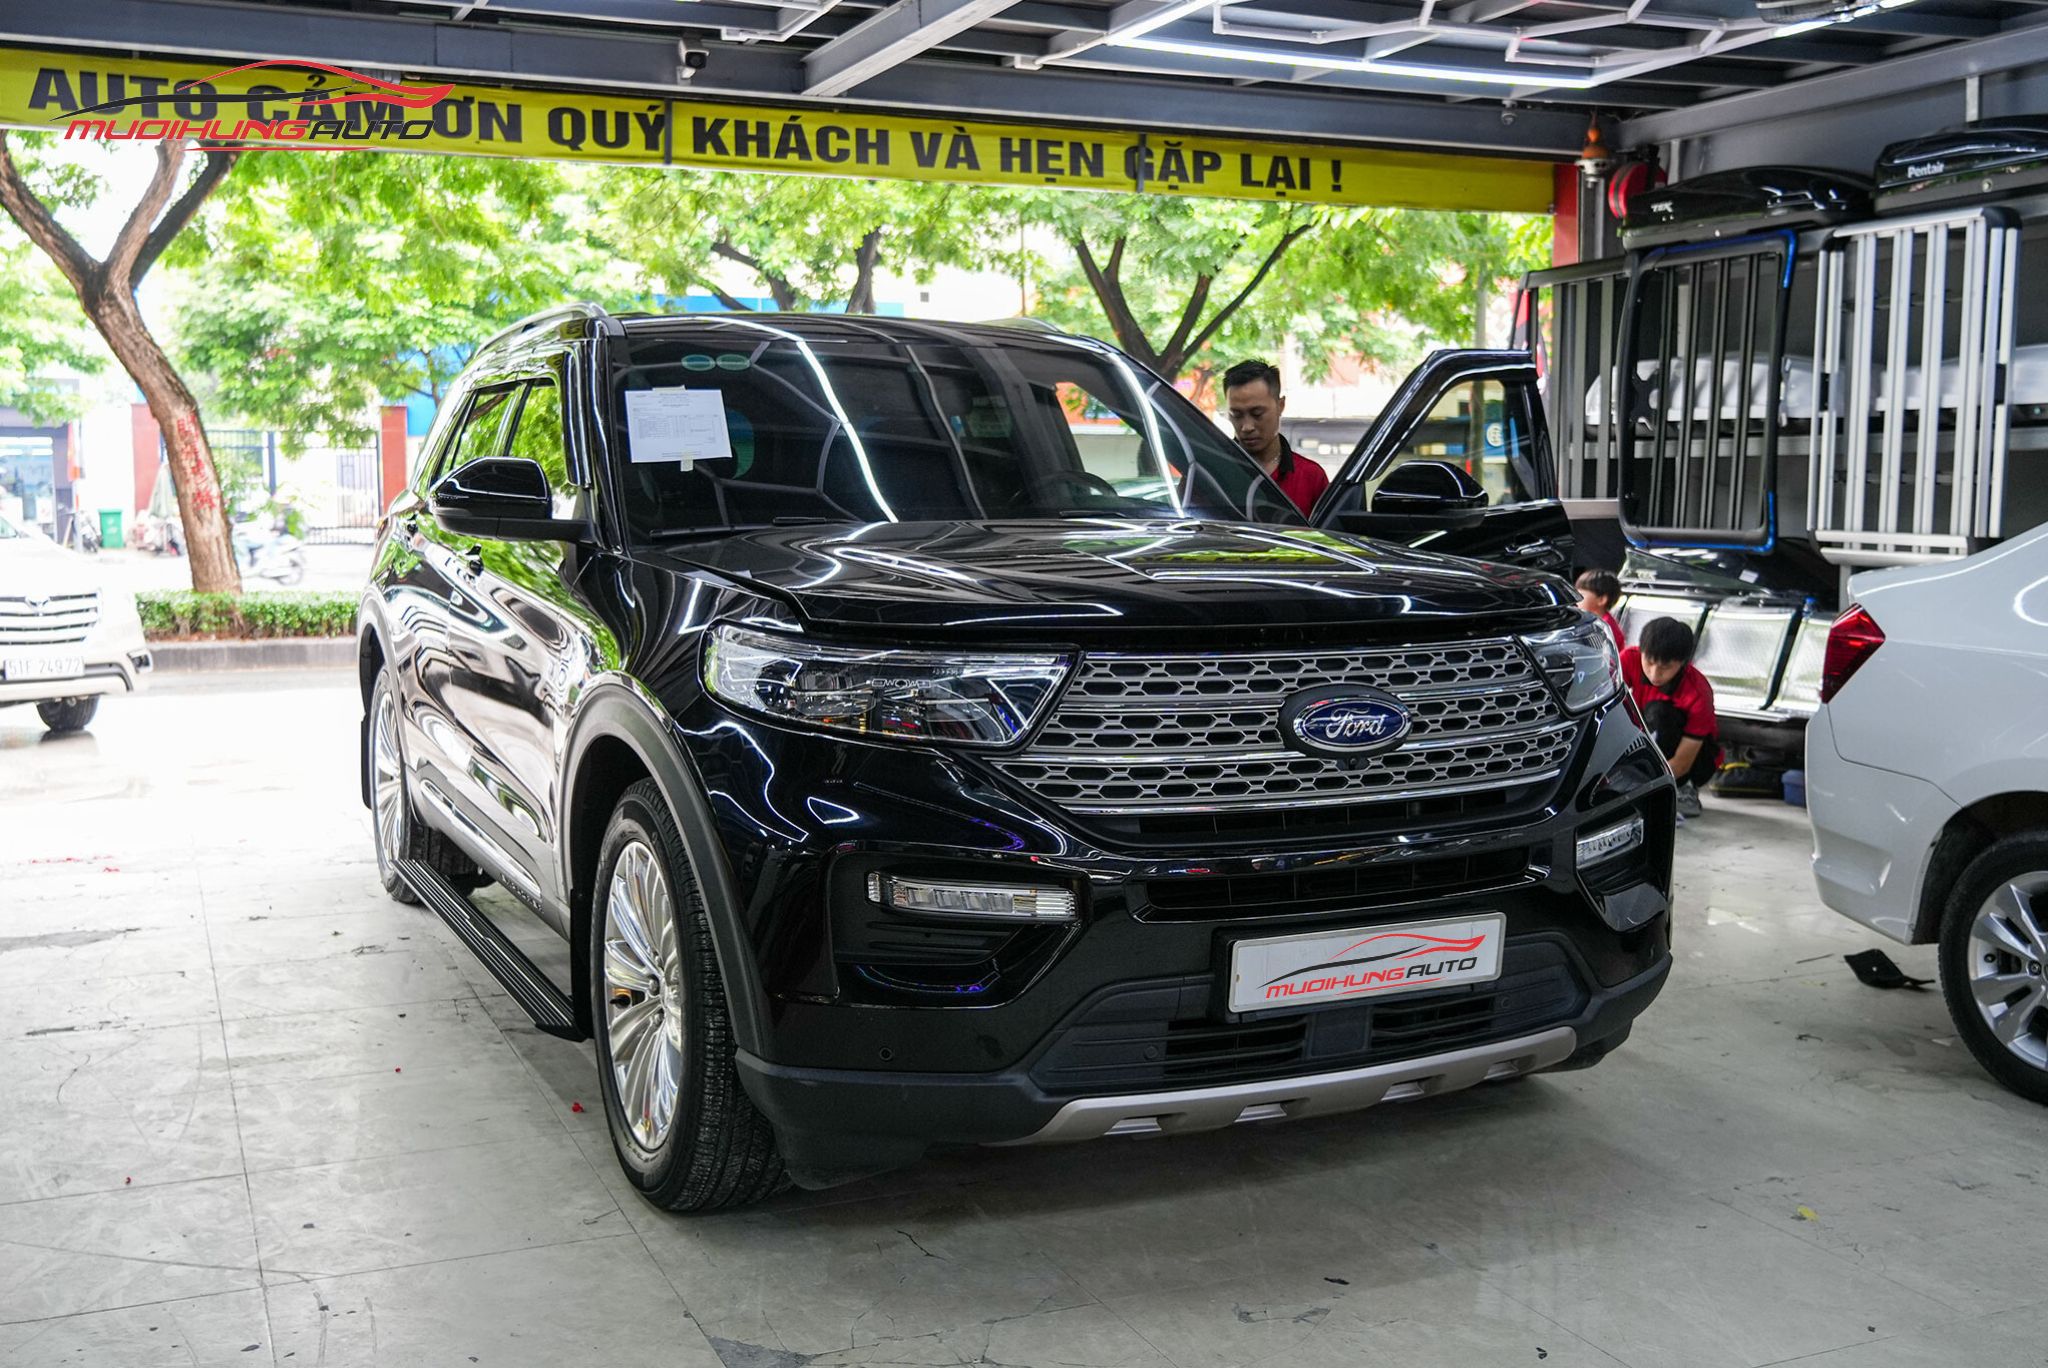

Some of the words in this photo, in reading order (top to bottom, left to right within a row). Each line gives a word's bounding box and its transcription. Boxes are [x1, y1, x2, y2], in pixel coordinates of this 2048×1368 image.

[28, 68, 217, 122] AUTO
[432, 96, 522, 144] ƠN
[548, 105, 665, 151] QUÝ
[693, 115, 889, 165] KHÁCH
[910, 126, 980, 170] VÀ
[1000, 137, 1104, 182] HẸN
[1124, 140, 1221, 190] GẶP
[1240, 153, 1311, 197] LẠI
[1908, 161, 1945, 178] Pentair
[1325, 707, 1388, 738] Ford
